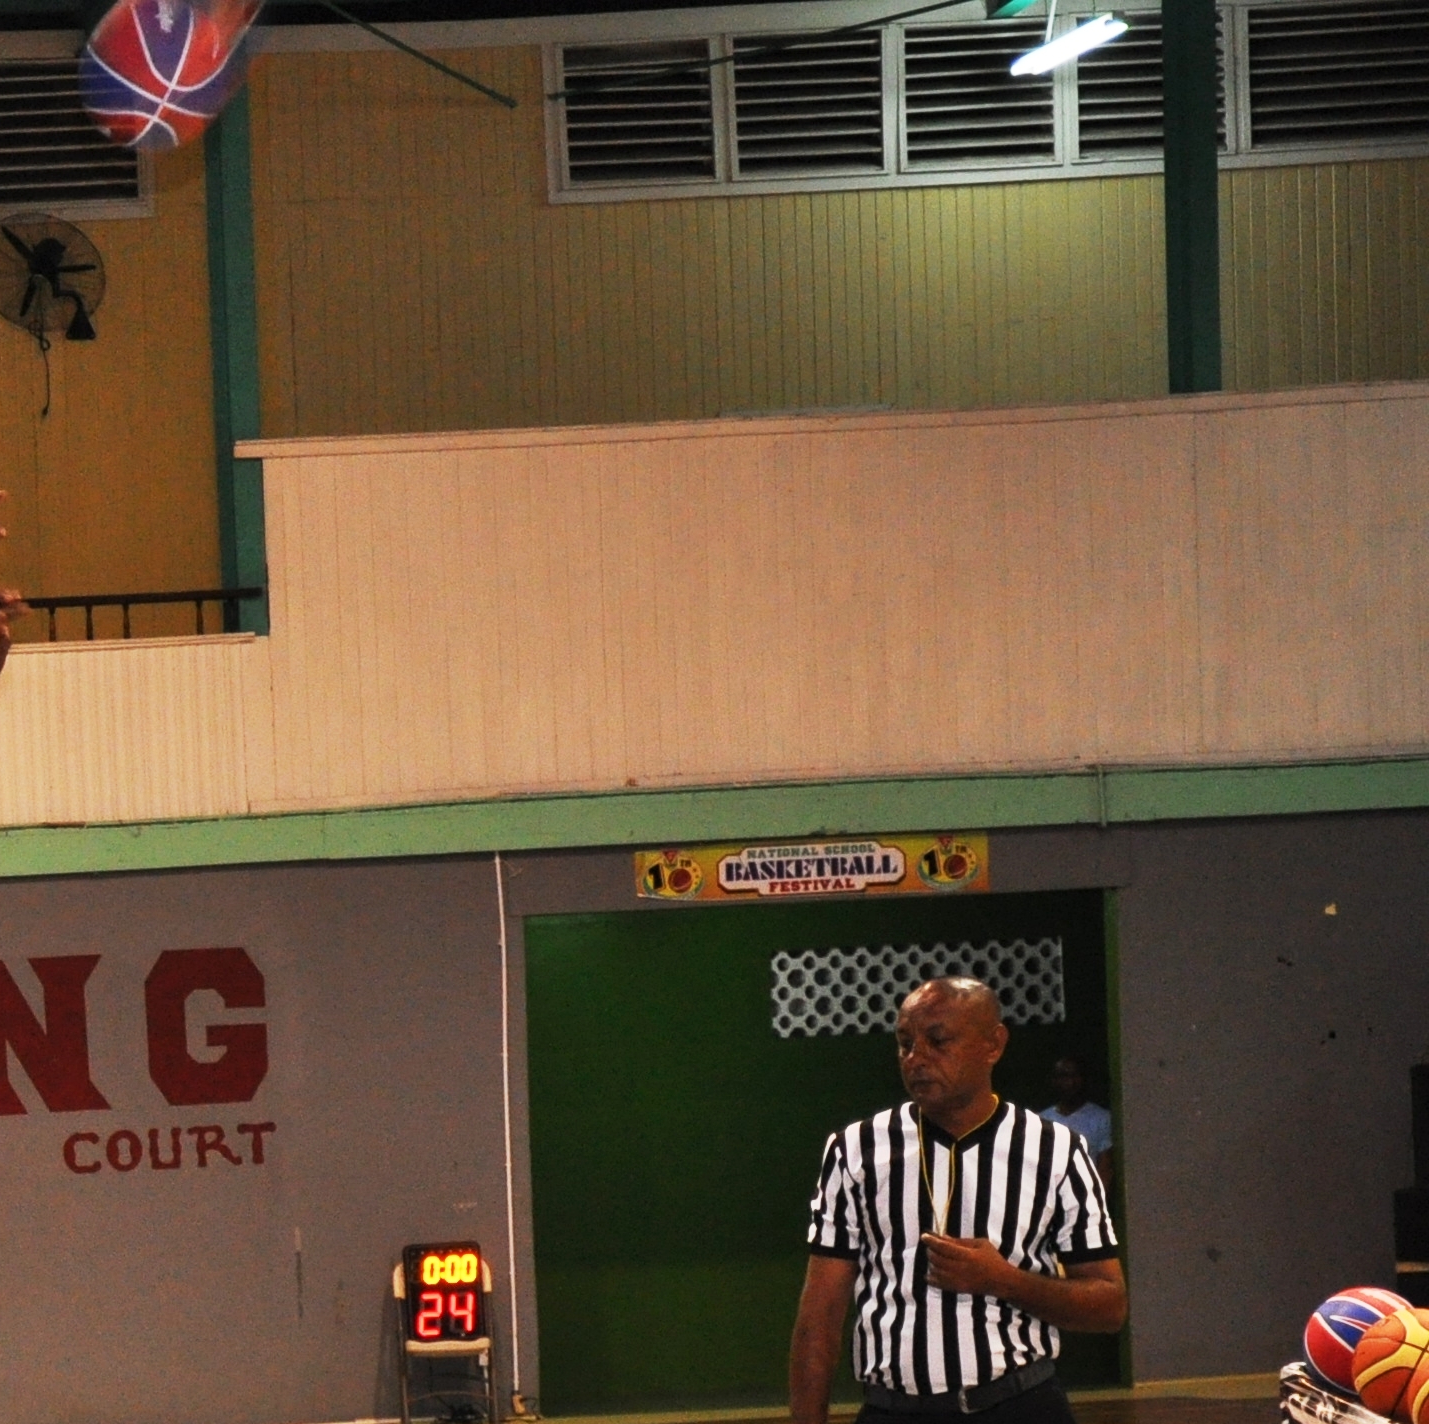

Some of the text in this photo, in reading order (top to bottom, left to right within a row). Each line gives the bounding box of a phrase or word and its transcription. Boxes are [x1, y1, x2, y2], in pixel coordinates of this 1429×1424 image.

[747, 846, 819, 859] NATIONAL
[725, 854, 899, 882] BASKETBALL
[768, 877, 856, 893] FESTIVAL
[63, 1120, 278, 1176] COURT
[422, 1253, 478, 1285] 0:00
[417, 1292, 475, 1337] 24
